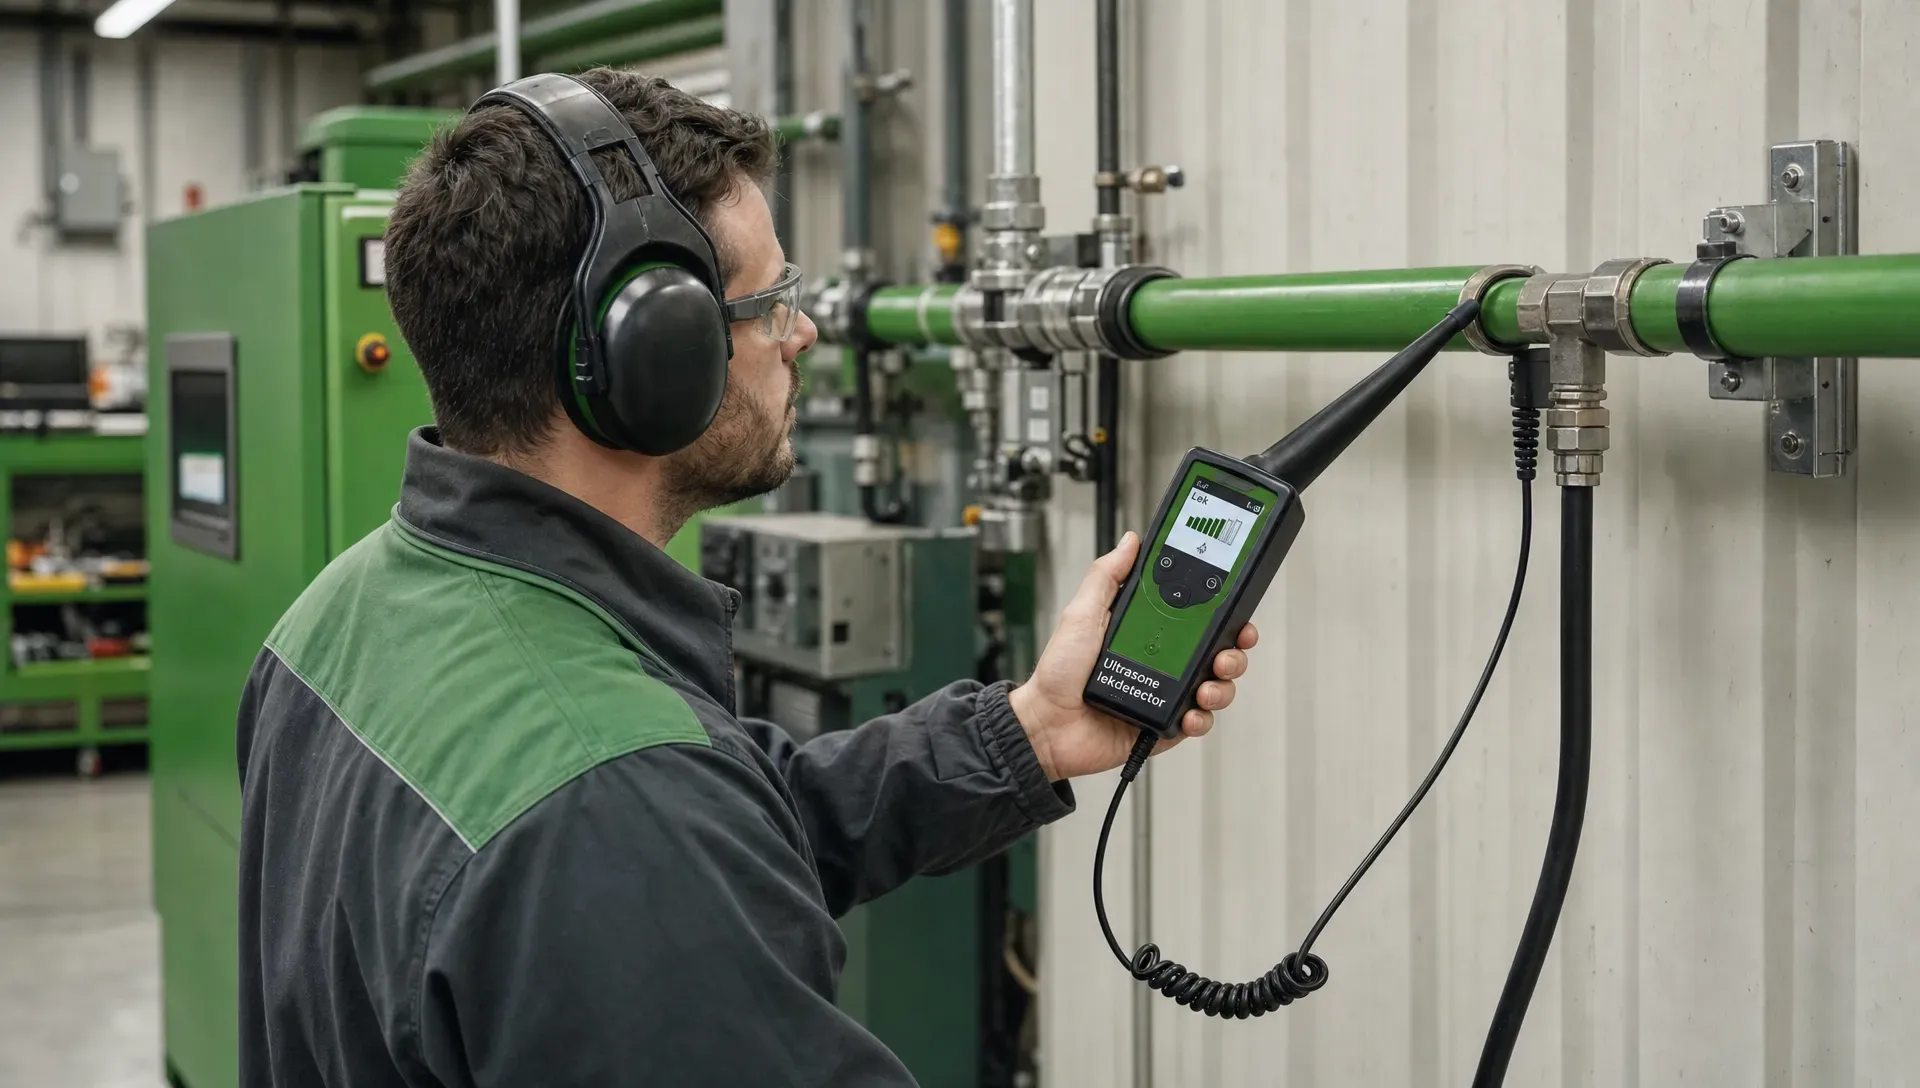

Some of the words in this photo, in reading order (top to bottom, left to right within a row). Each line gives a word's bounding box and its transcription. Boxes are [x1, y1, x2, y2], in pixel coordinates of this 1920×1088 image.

[1191, 491, 1209, 506] Lek
[1103, 657, 1160, 689] Ultrasone
[1097, 671, 1166, 708] lekdetector
